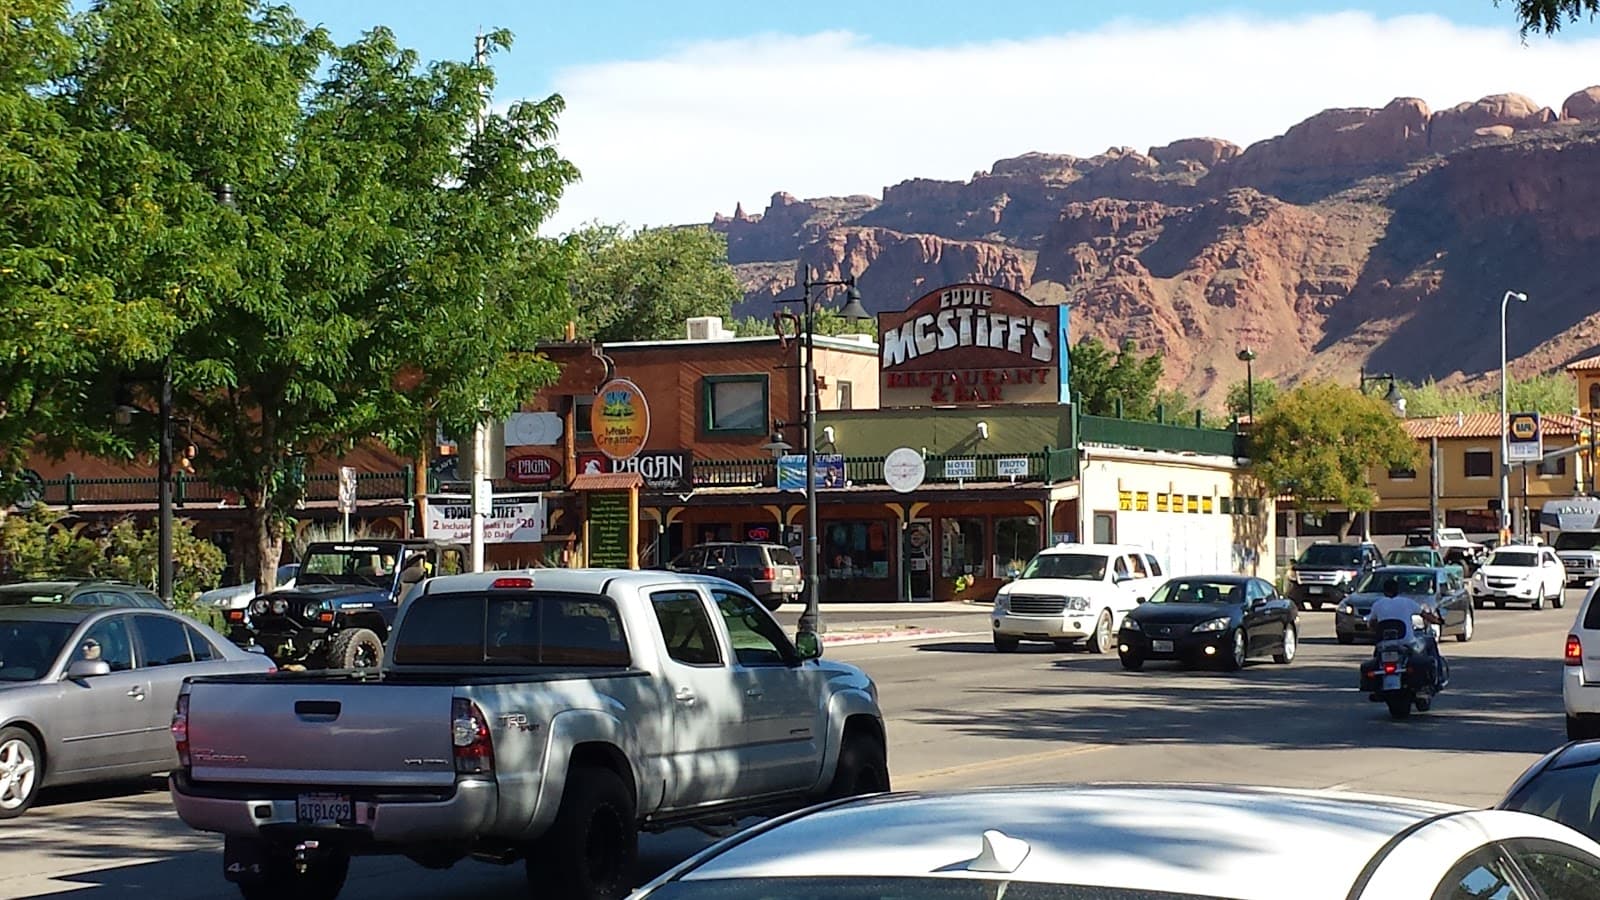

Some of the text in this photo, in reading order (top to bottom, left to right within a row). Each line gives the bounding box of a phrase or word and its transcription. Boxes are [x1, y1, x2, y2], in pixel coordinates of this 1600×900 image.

[940, 288, 993, 308] EDDIE
[887, 368, 1051, 389] RESTAURANT
[931, 387, 1003, 403] & BAR
[518, 459, 551, 473] PAGAN
[612, 455, 683, 478] PAGAN
[432, 520, 439, 530] 2
[441, 522, 472, 530] Inclusiv
[498, 713, 527, 728] TRD
